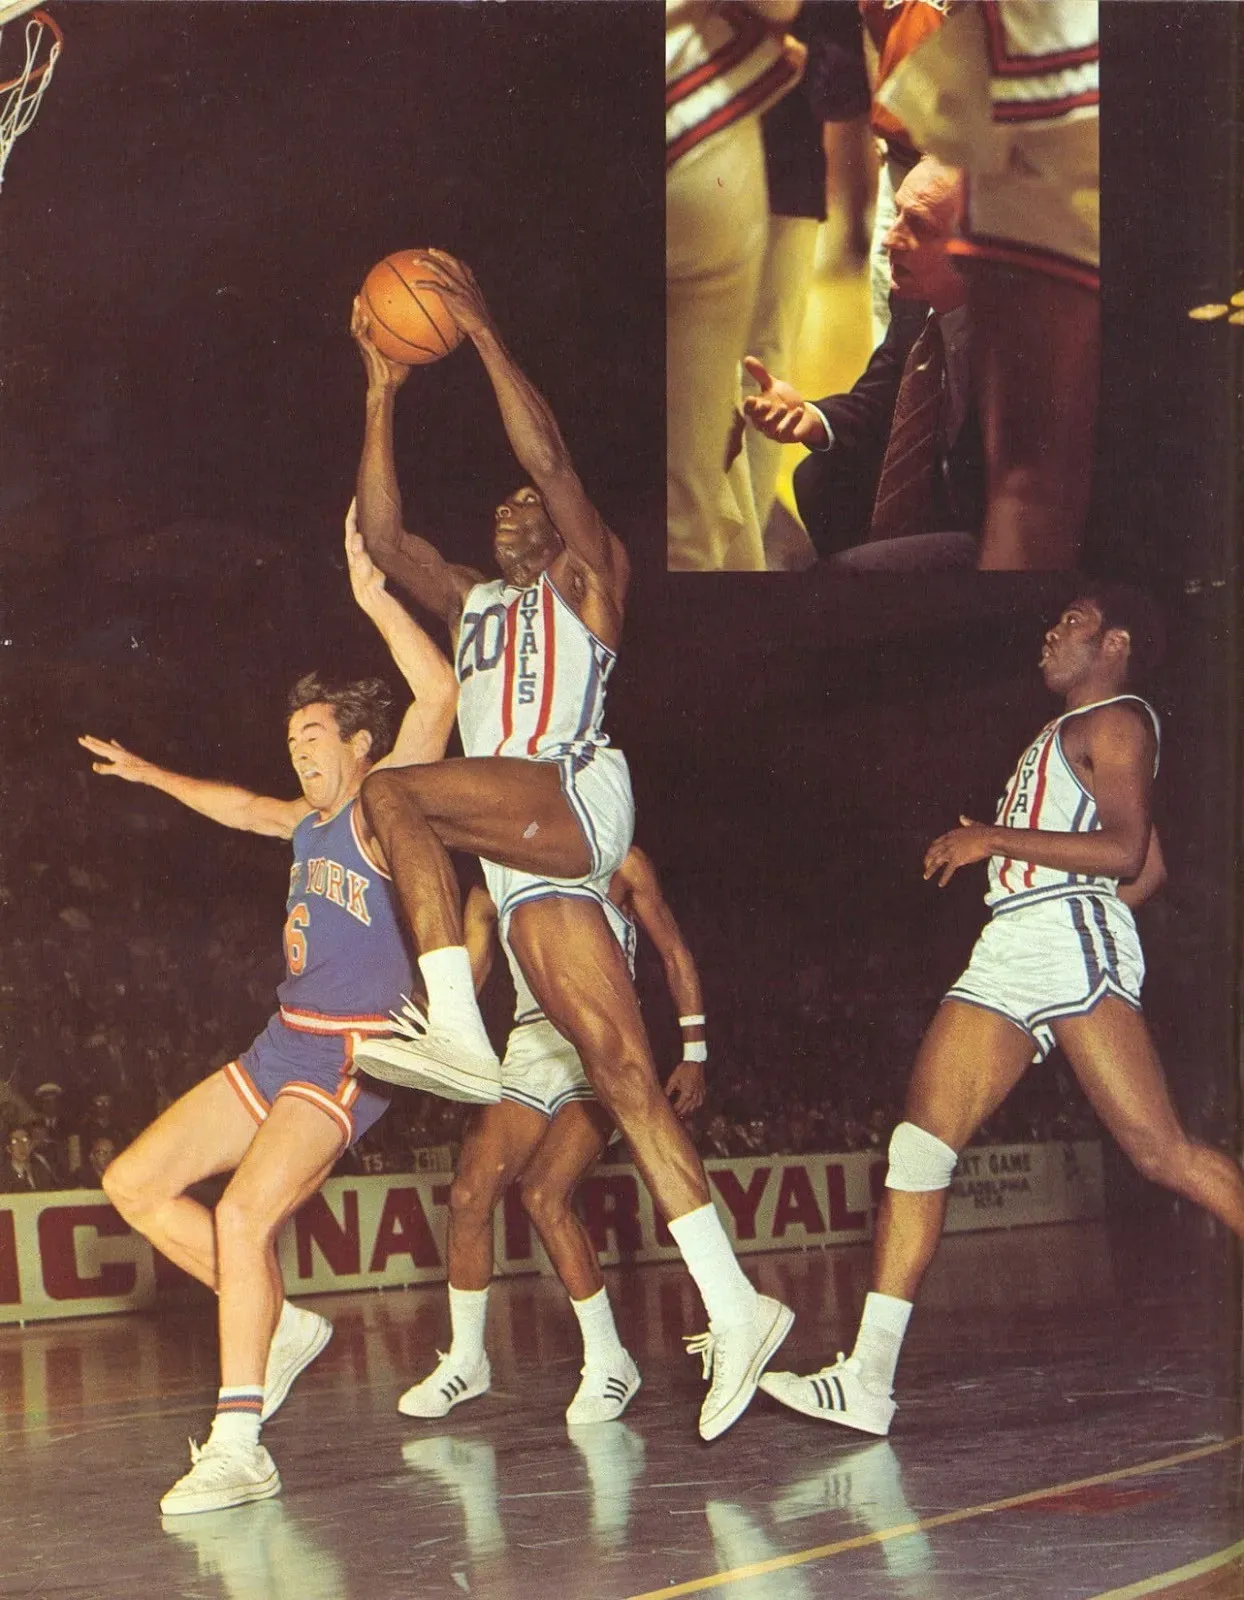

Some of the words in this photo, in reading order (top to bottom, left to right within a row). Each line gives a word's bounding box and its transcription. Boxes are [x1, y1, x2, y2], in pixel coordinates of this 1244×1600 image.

[458, 603, 507, 683] 20
[518, 588, 539, 705] OYALS
[305, 857, 371, 927] YORK
[285, 902, 310, 976] 6
